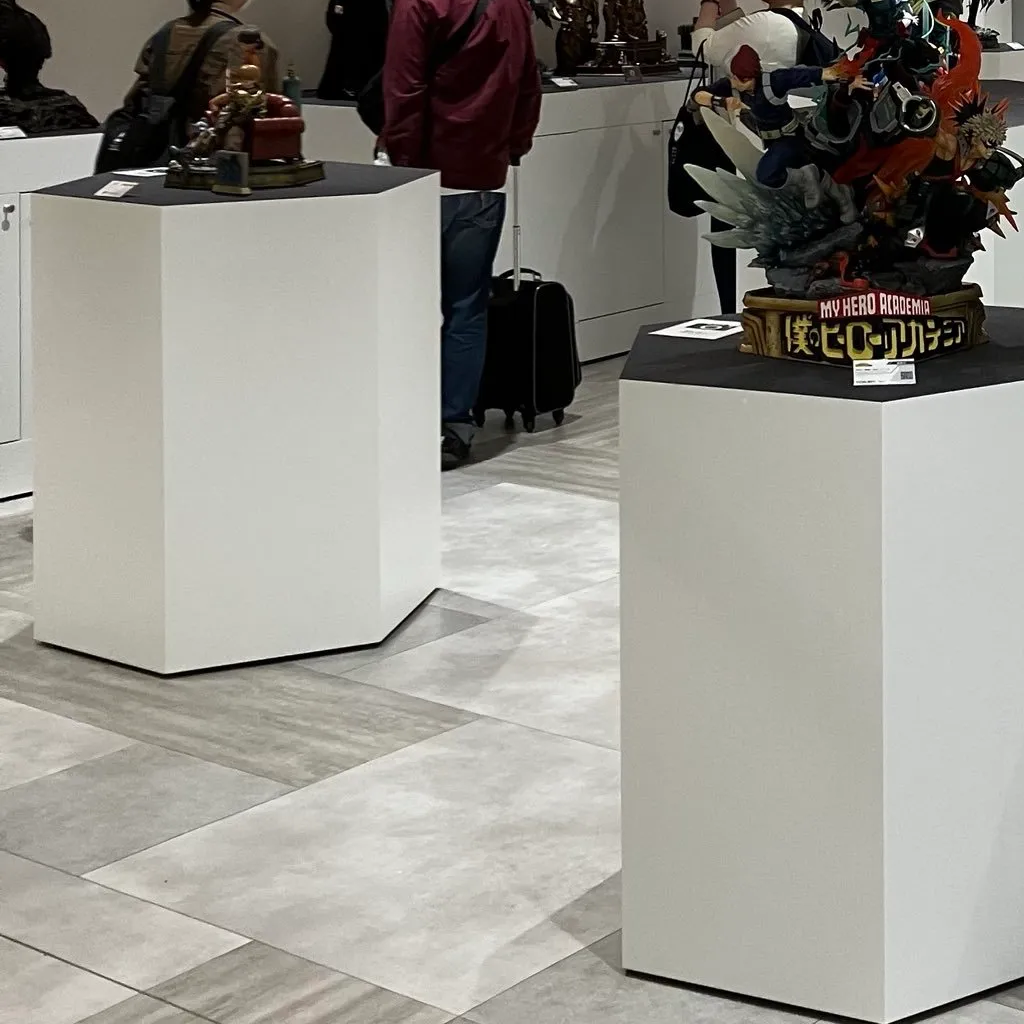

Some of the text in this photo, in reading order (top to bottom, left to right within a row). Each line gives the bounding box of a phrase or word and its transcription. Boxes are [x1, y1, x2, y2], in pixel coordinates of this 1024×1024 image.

[820, 292, 930, 318] MY HERO ACADEMIA
